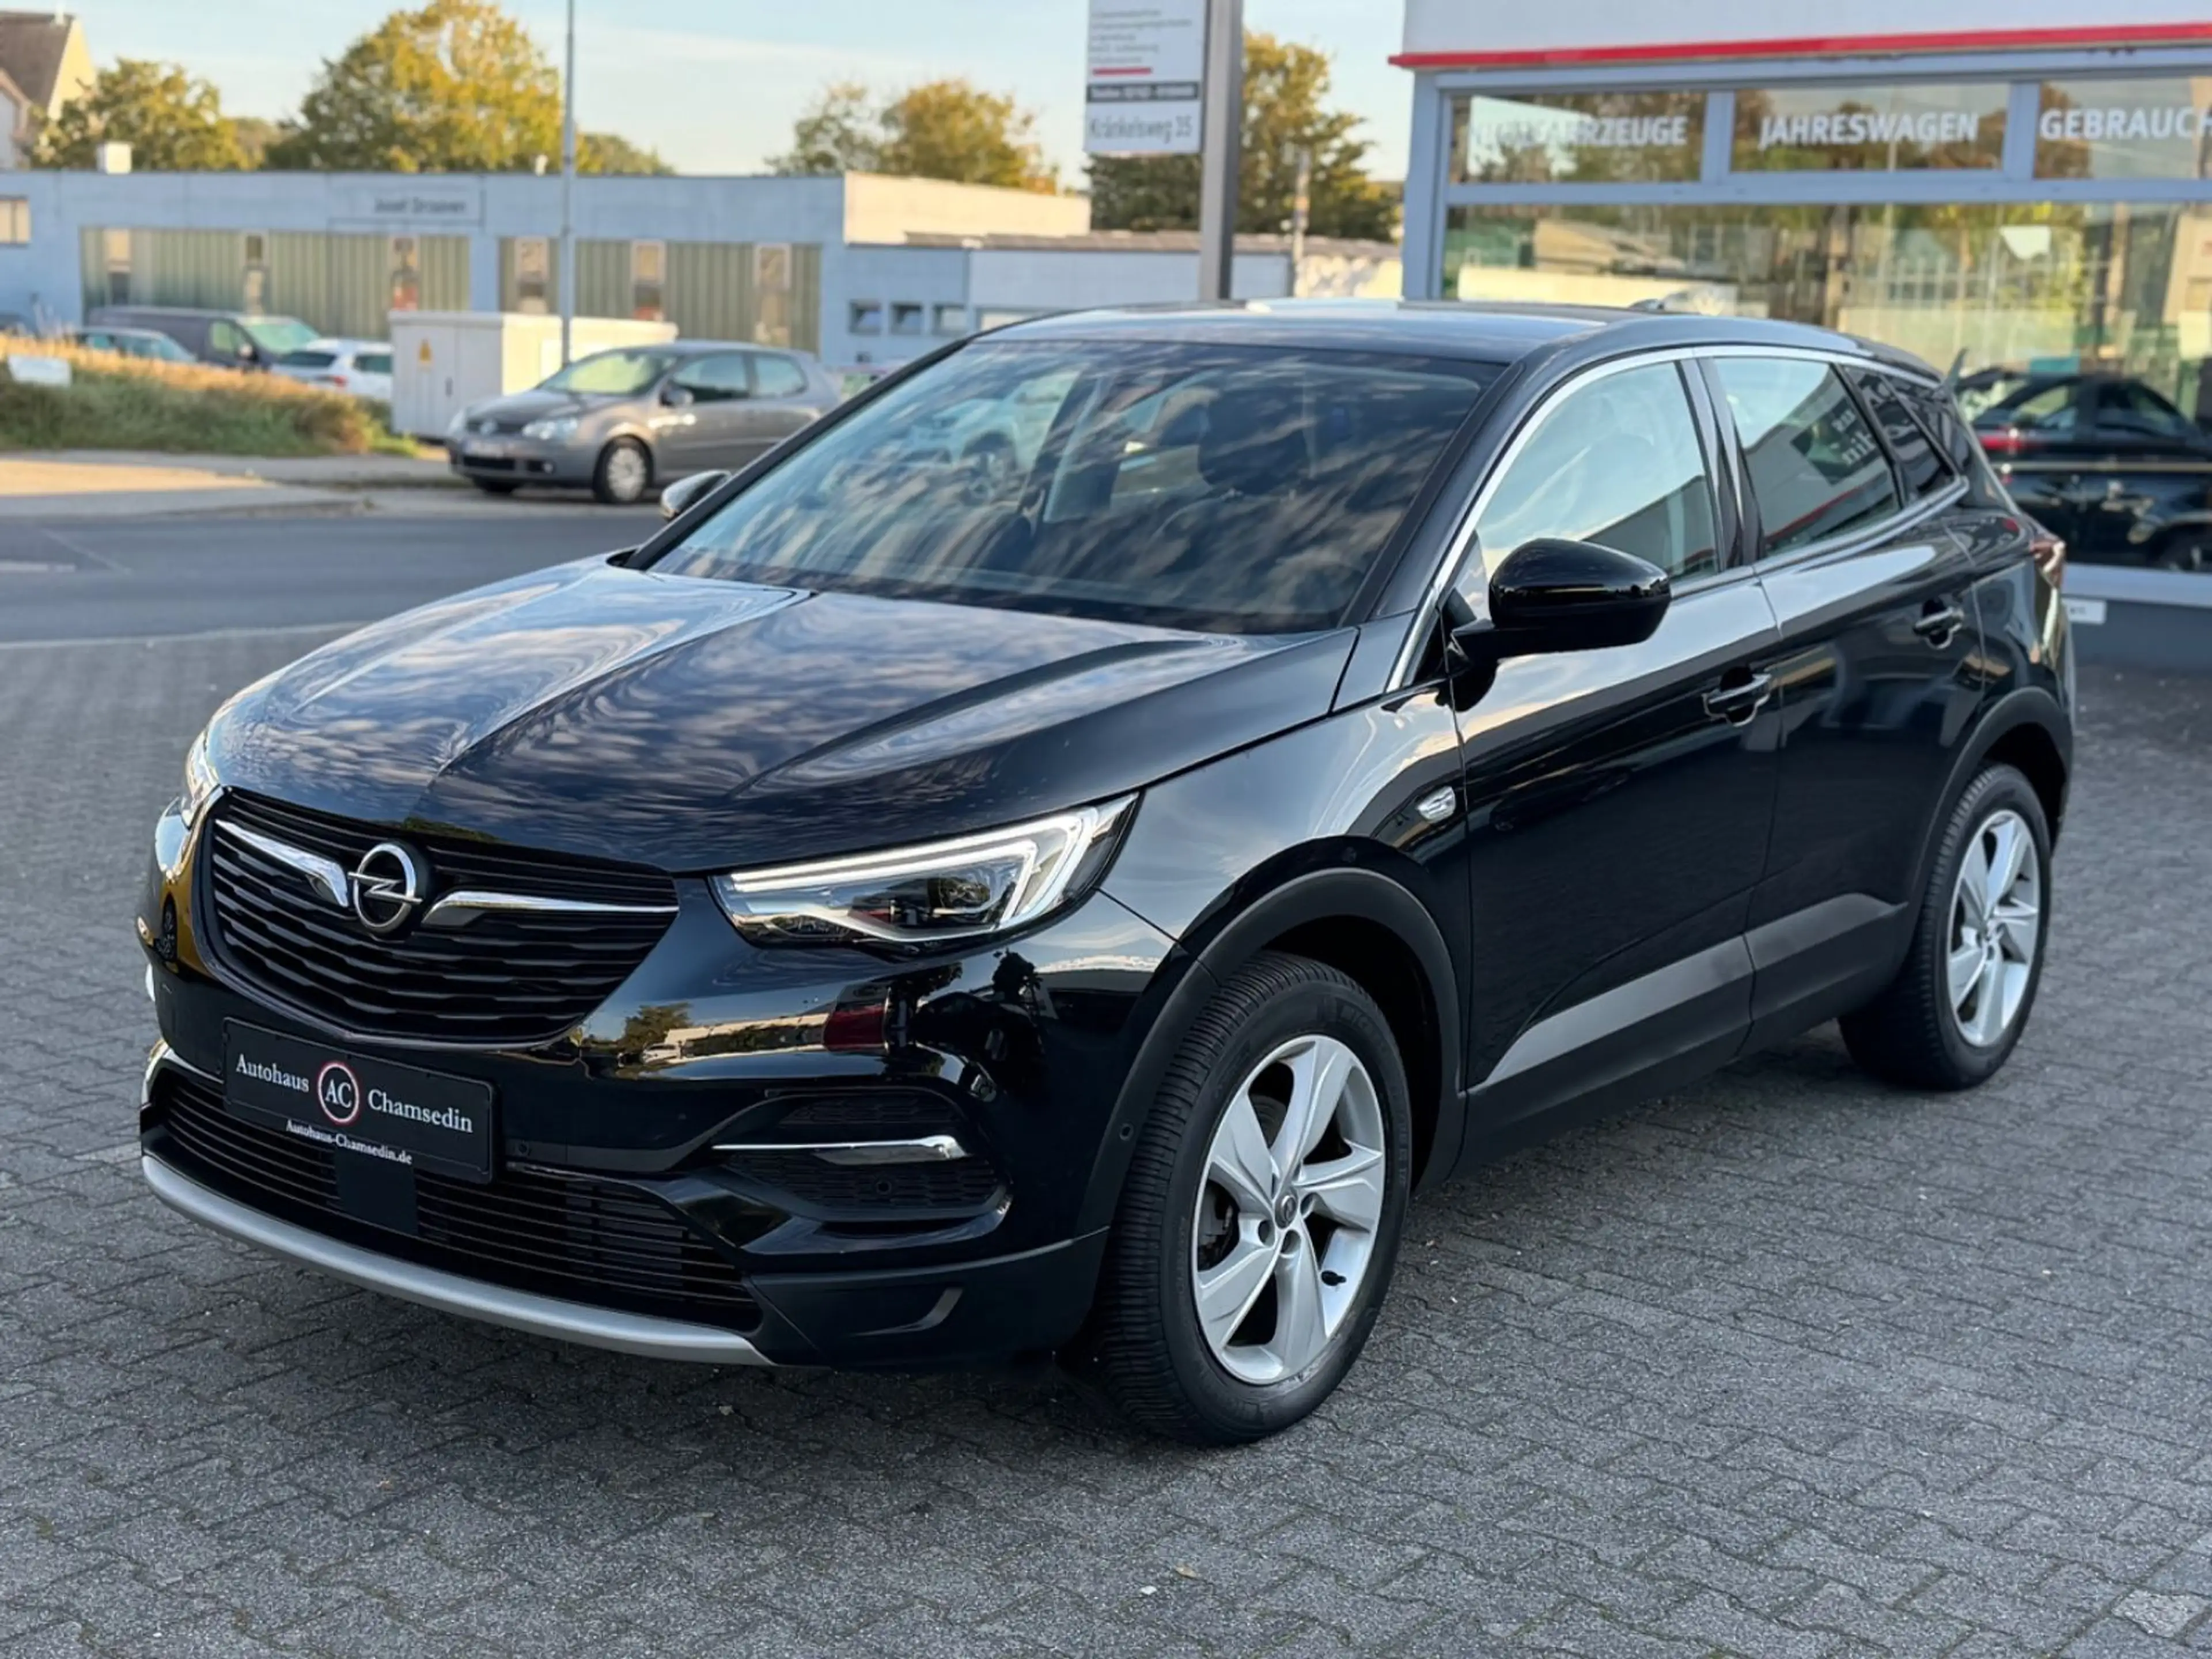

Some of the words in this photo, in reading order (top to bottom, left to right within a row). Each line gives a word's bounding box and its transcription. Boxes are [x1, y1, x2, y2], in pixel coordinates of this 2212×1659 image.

[1758, 111, 1979, 151] JAHRESWAGEN
[235, 1053, 310, 1093] Autohaus
[324, 1078, 353, 1108] AC
[367, 1088, 474, 1134] Chamsedin
[286, 1119, 412, 1165] Autohaus-Chamsedin.de
